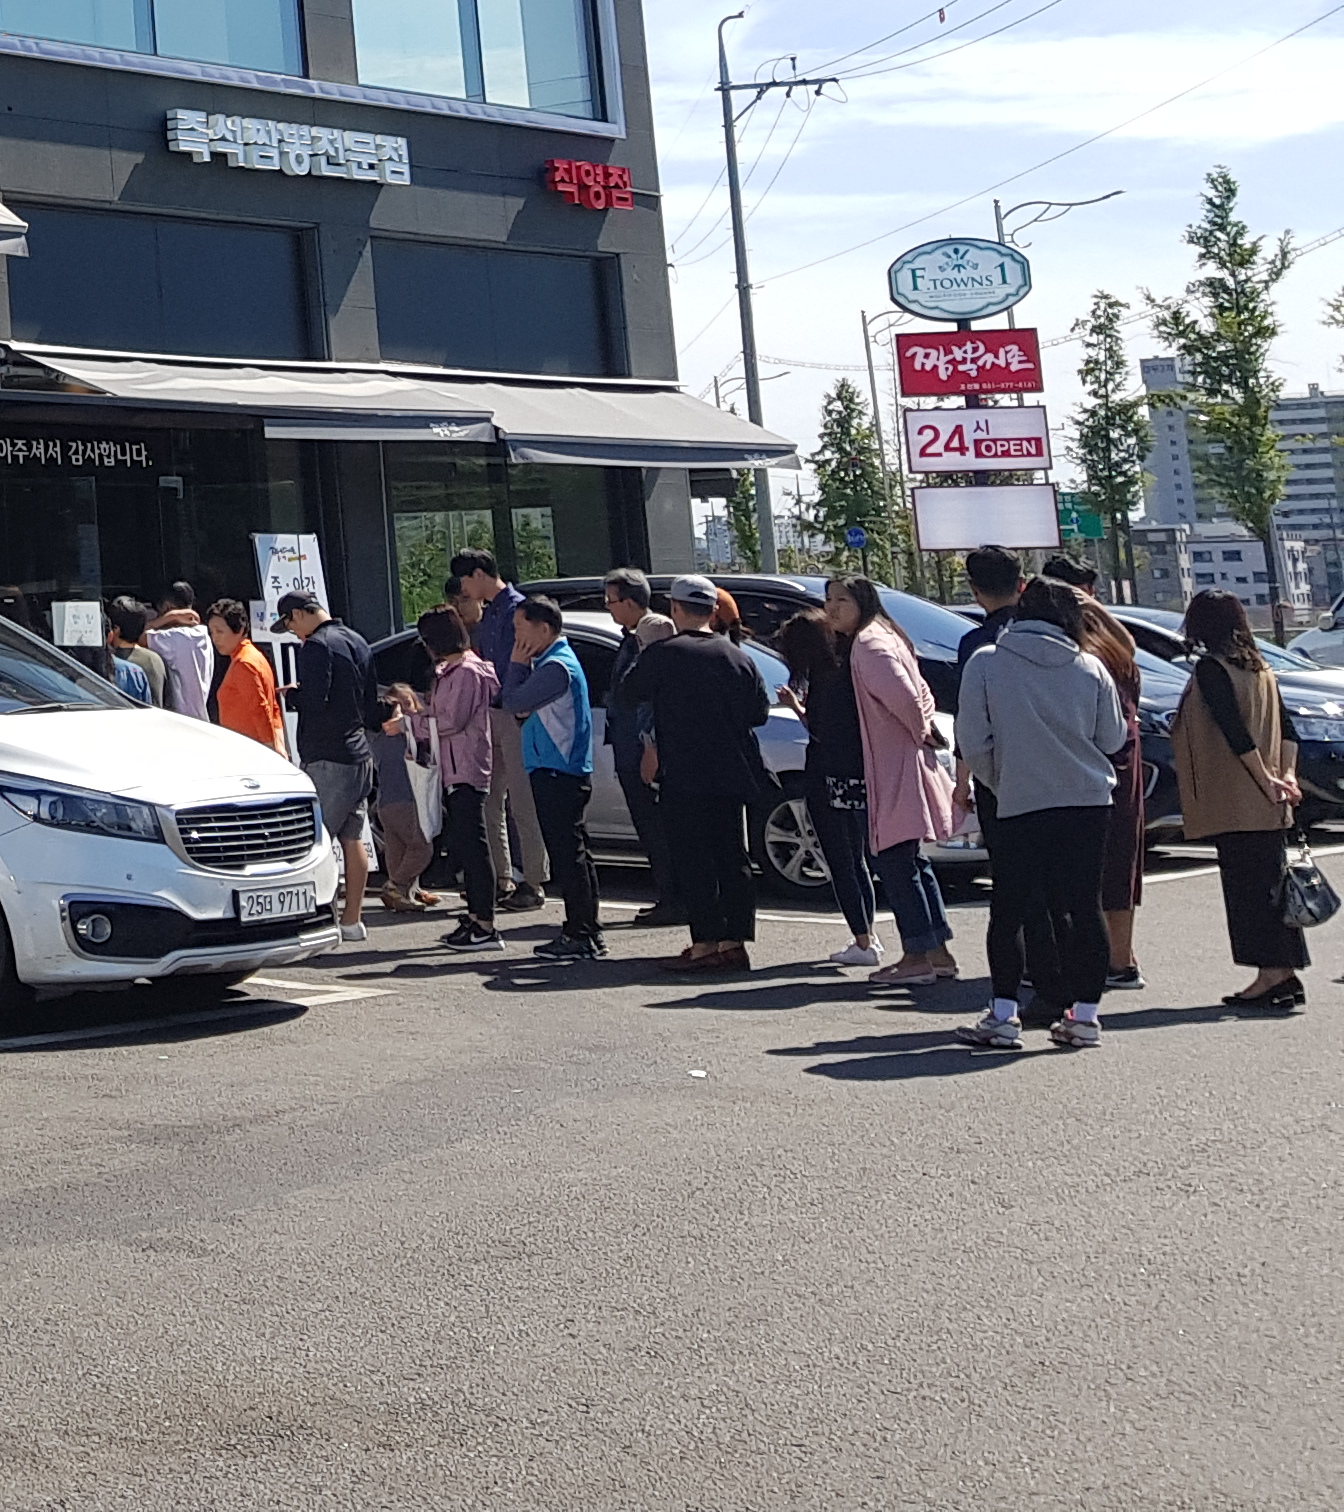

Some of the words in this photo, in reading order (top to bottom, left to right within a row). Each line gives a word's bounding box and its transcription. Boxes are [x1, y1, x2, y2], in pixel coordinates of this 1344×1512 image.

[544, 158, 634, 211] 직영점
[905, 340, 1035, 381] 짬뽕지존
[68, 440, 153, 468] 감사합니다.
[980, 440, 1037, 456] OPEN
[277, 888, 308, 914] 9711
